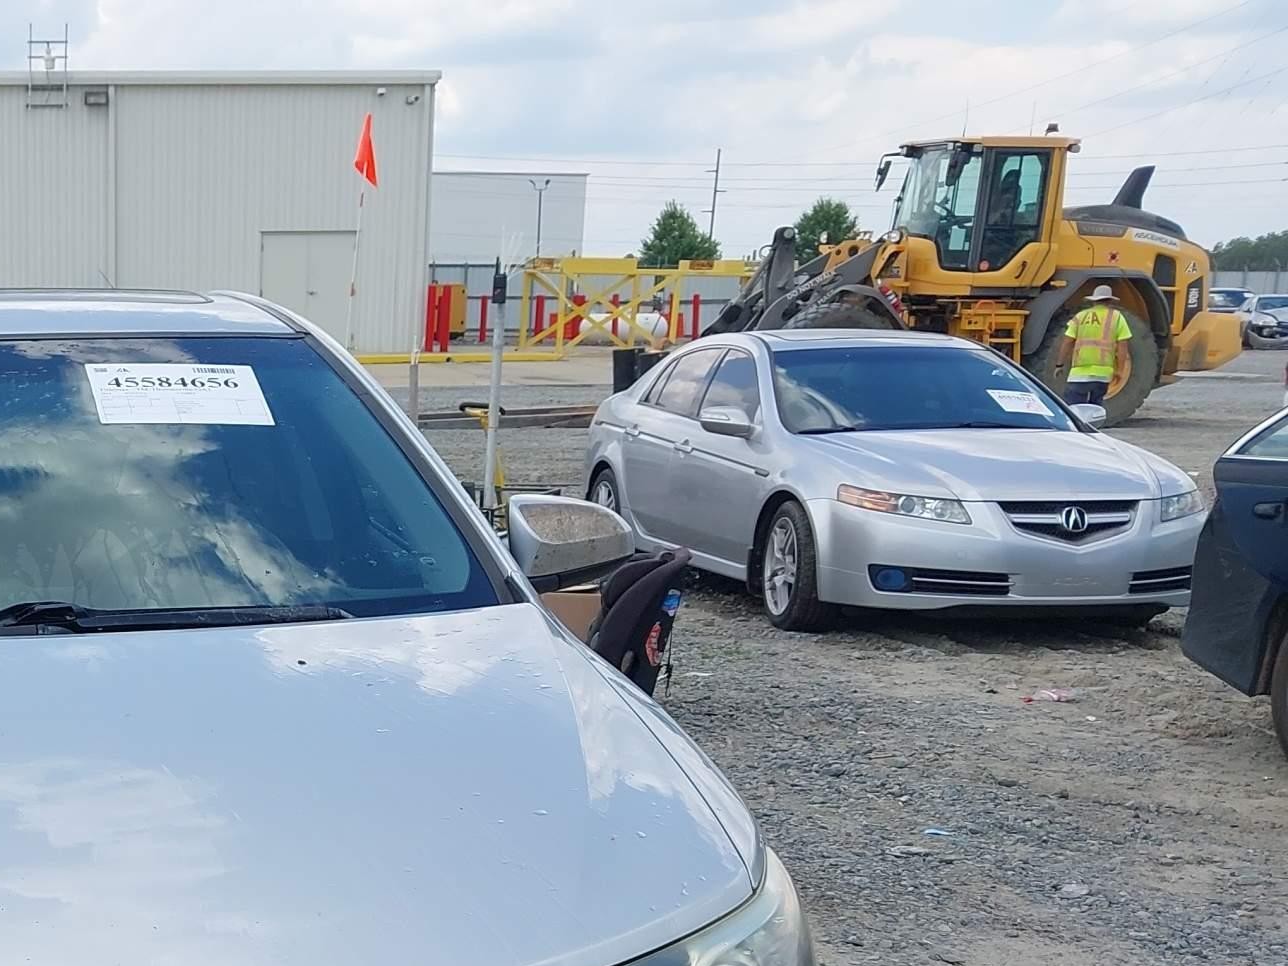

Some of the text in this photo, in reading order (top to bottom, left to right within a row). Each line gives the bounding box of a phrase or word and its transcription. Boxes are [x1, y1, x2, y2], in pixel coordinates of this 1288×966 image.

[787, 290, 798, 300] DO
[799, 281, 814, 294] NOT
[107, 376, 240, 389] 45584656
